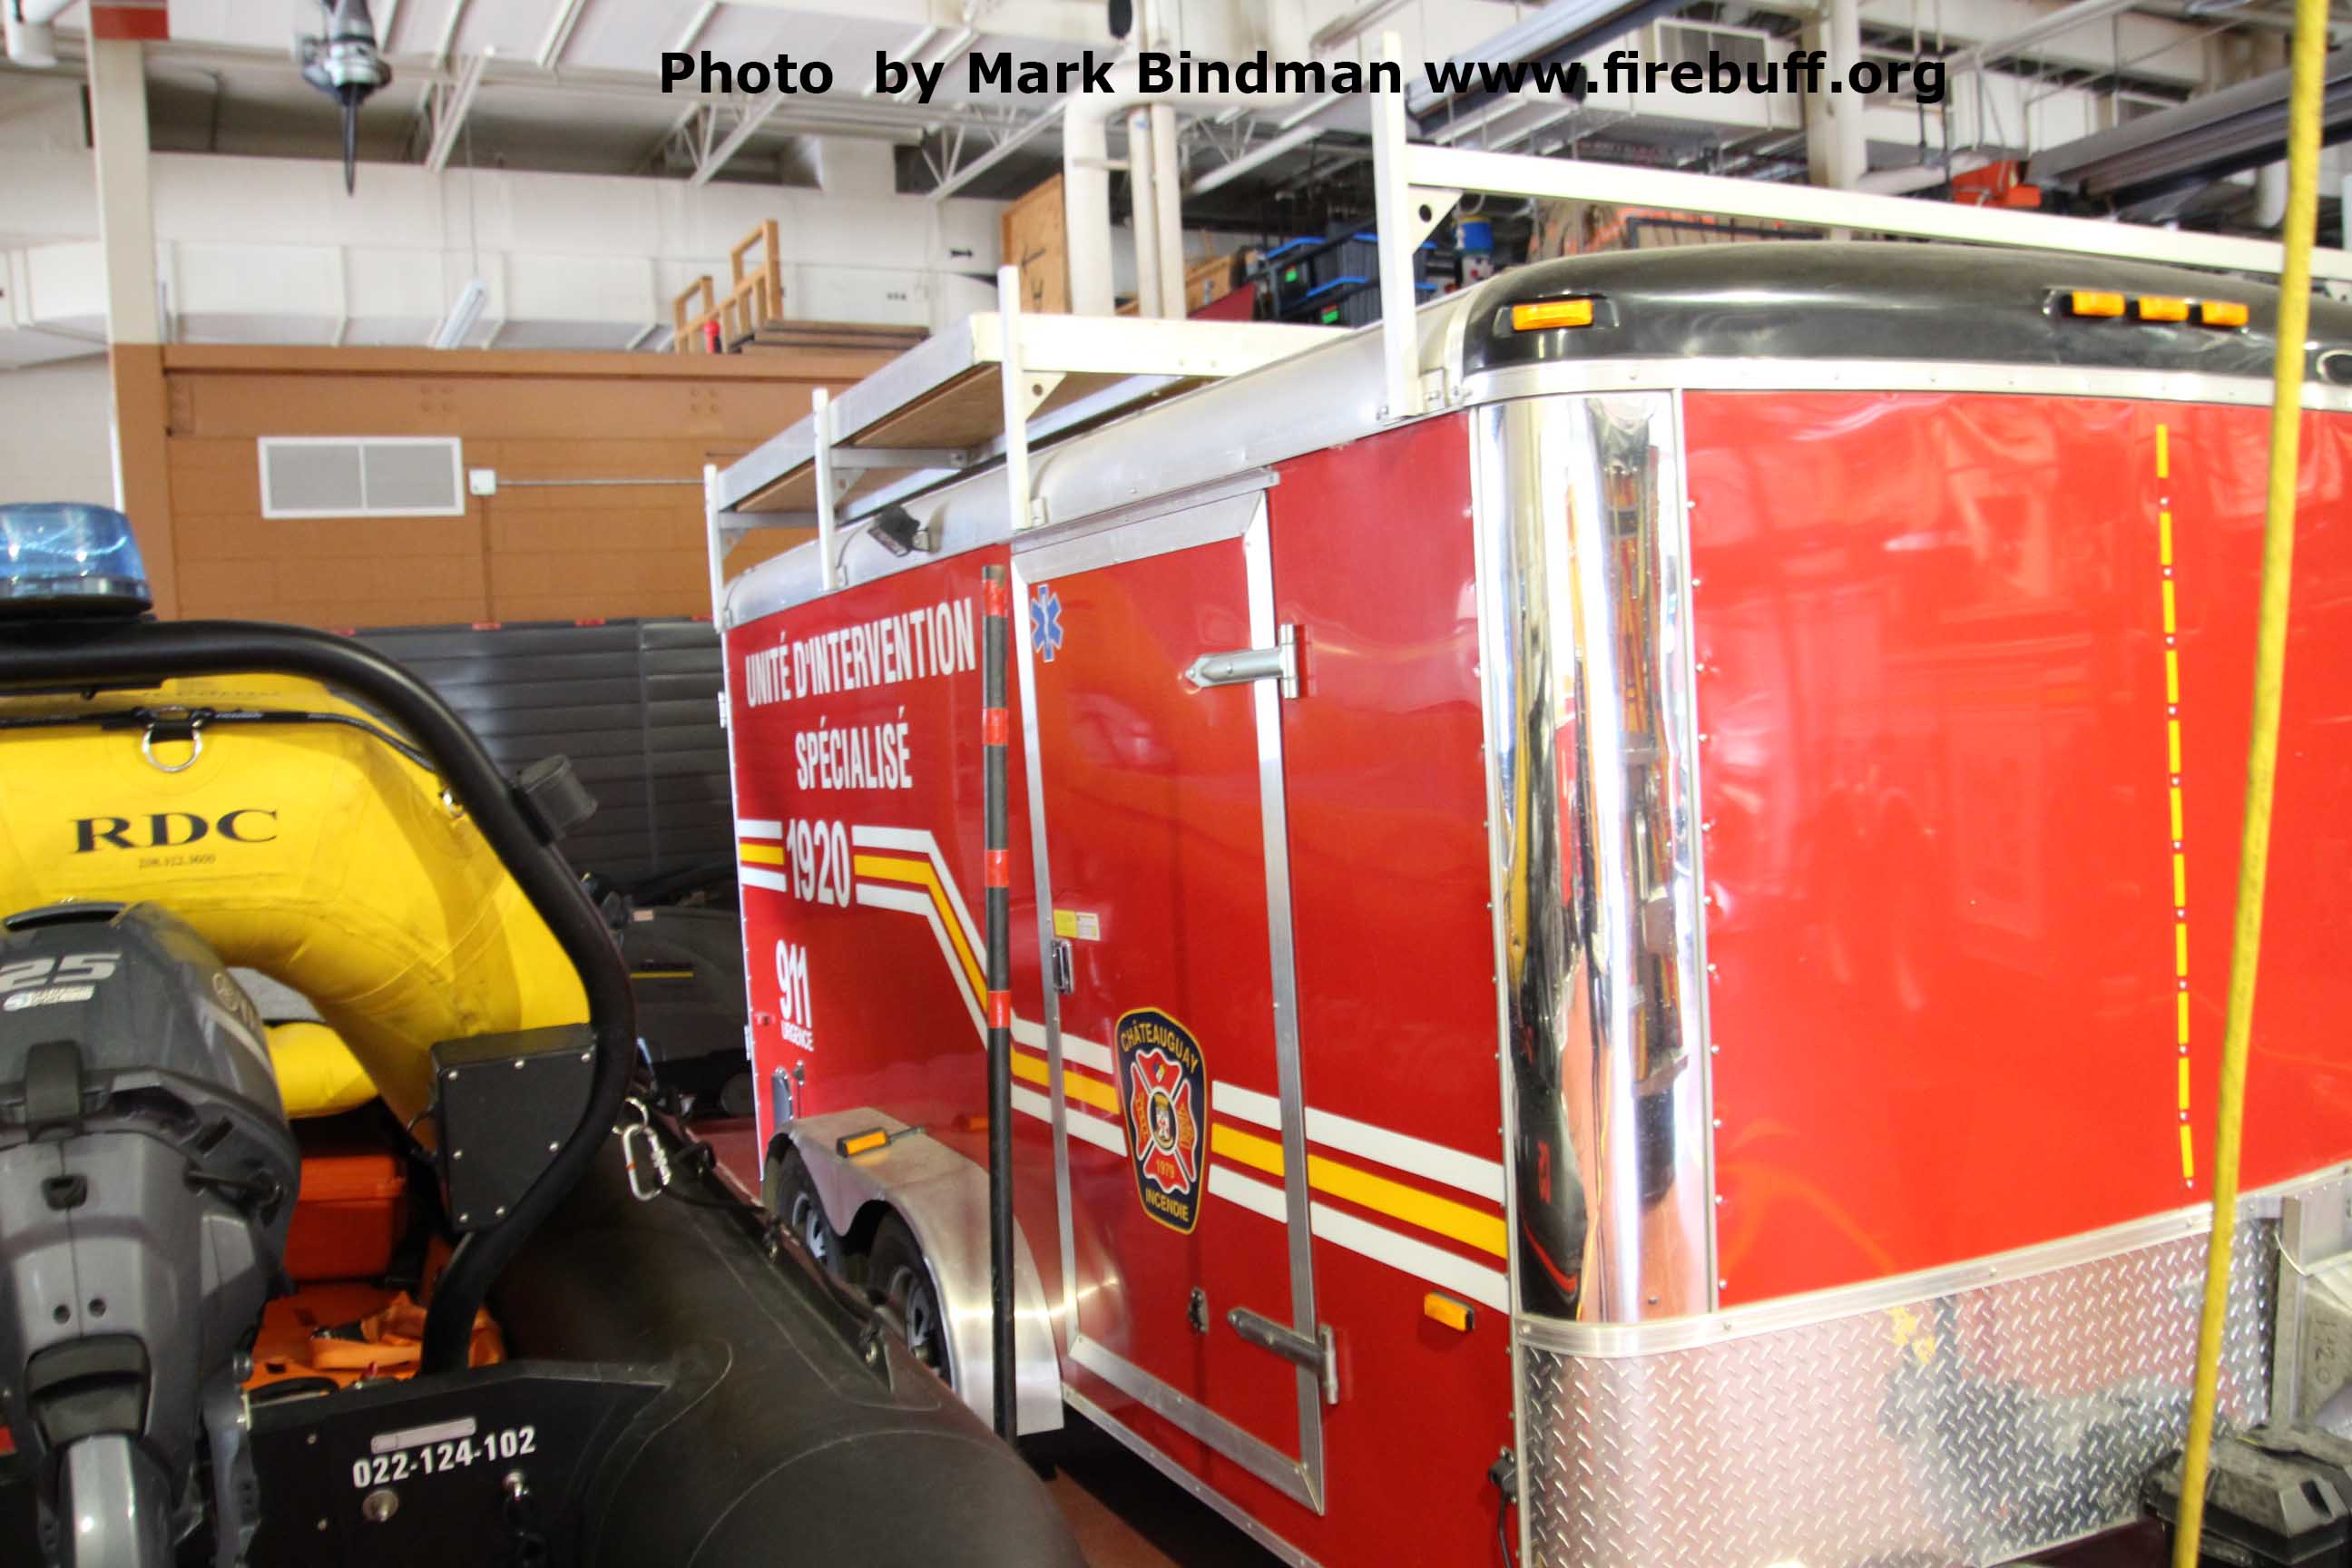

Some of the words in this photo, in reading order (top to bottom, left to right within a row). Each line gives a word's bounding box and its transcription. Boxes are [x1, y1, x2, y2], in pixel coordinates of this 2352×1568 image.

[745, 629, 792, 708] UNITÉ
[792, 597, 976, 699] D'INTERVENTION
[795, 705, 913, 790] SPÉCIALISÉ
[67, 808, 278, 854] RDC
[786, 818, 851, 908] 1920
[0, 952, 122, 994] 25
[776, 939, 812, 1028] 911
[1120, 1018, 1199, 1074] CHÂTEAUGUAY
[1145, 1188, 1190, 1222] INCENDIE
[352, 1426, 536, 1489] 022-124-102
